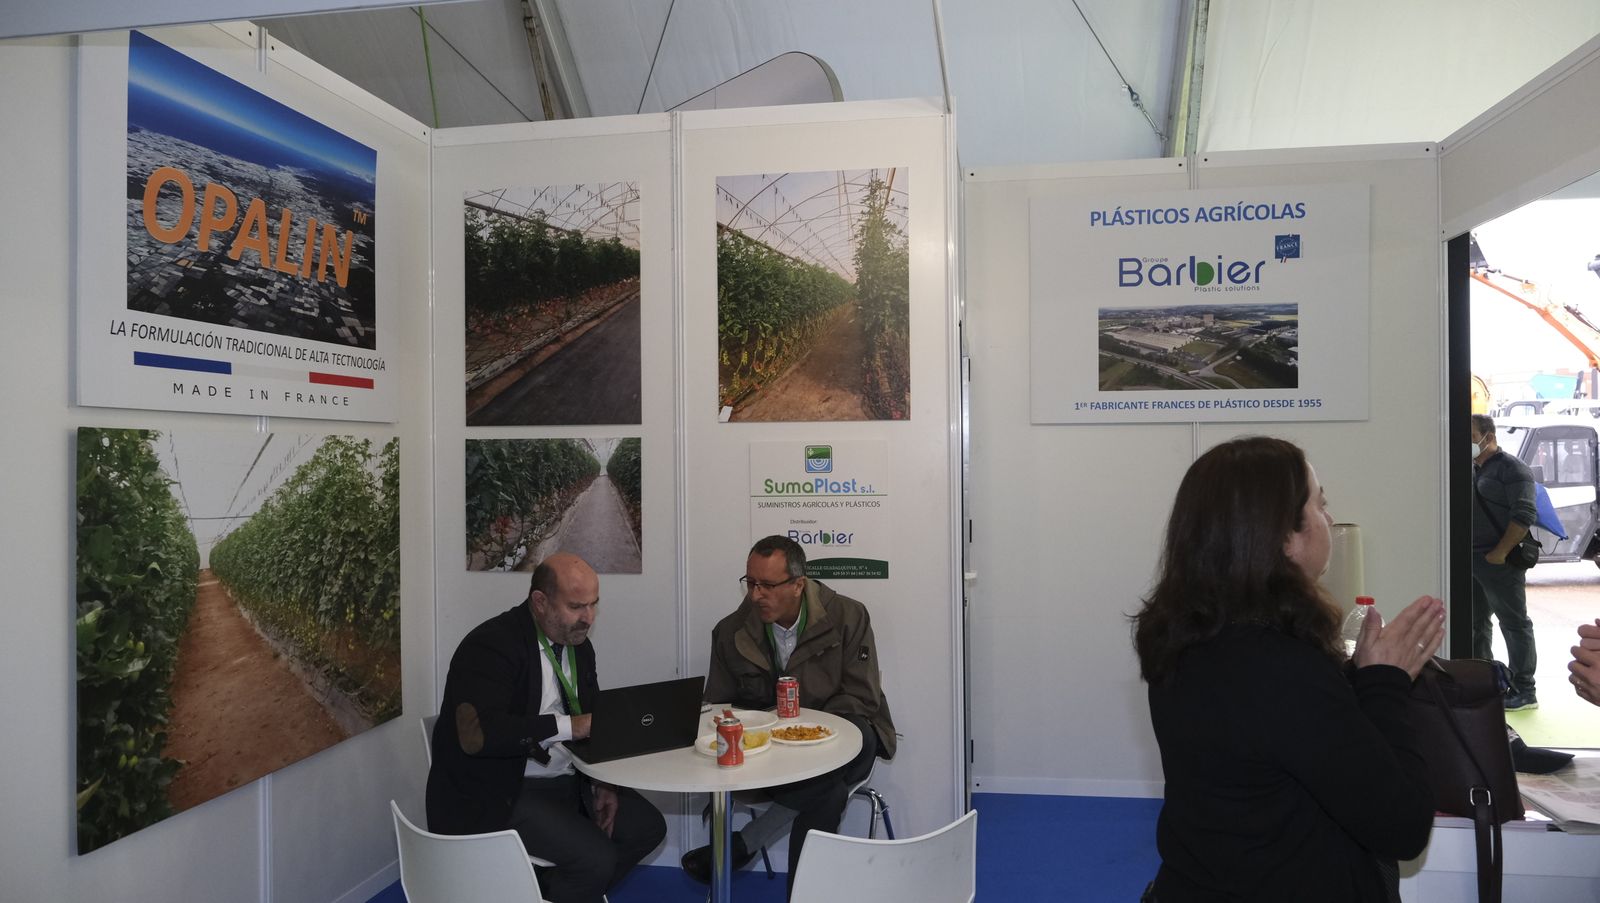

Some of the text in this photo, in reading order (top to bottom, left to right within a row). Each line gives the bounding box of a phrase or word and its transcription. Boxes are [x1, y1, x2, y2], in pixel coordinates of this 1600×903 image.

[1090, 201, 1306, 227] PLÁSTICOS AGRÍCOLAS
[142, 167, 353, 289] OPALIN
[1118, 255, 1266, 287] Barbier
[110, 319, 126, 336] LA
[131, 322, 223, 349] FORMULACIÓN
[226, 337, 292, 359] TRADICIONAL
[295, 347, 308, 360] DE
[309, 350, 330, 363] ALTA
[173, 382, 349, 406] MADE IN FRANCE
[1090, 401, 1149, 410] FABRICANTE
[1152, 400, 1196, 409] FRANCES
[1198, 400, 1211, 409] DE
[1213, 398, 1260, 408] PLÁSTICO
[1263, 399, 1295, 408] DESDE
[1297, 398, 1322, 408] 1955
[764, 478, 857, 493] SumaPlast
[758, 501, 801, 509] SUMINISTROS
[802, 500, 839, 508] AGRÍCOLAS
[845, 500, 881, 508] PLÁSTICOS
[788, 529, 854, 544] Barbier
